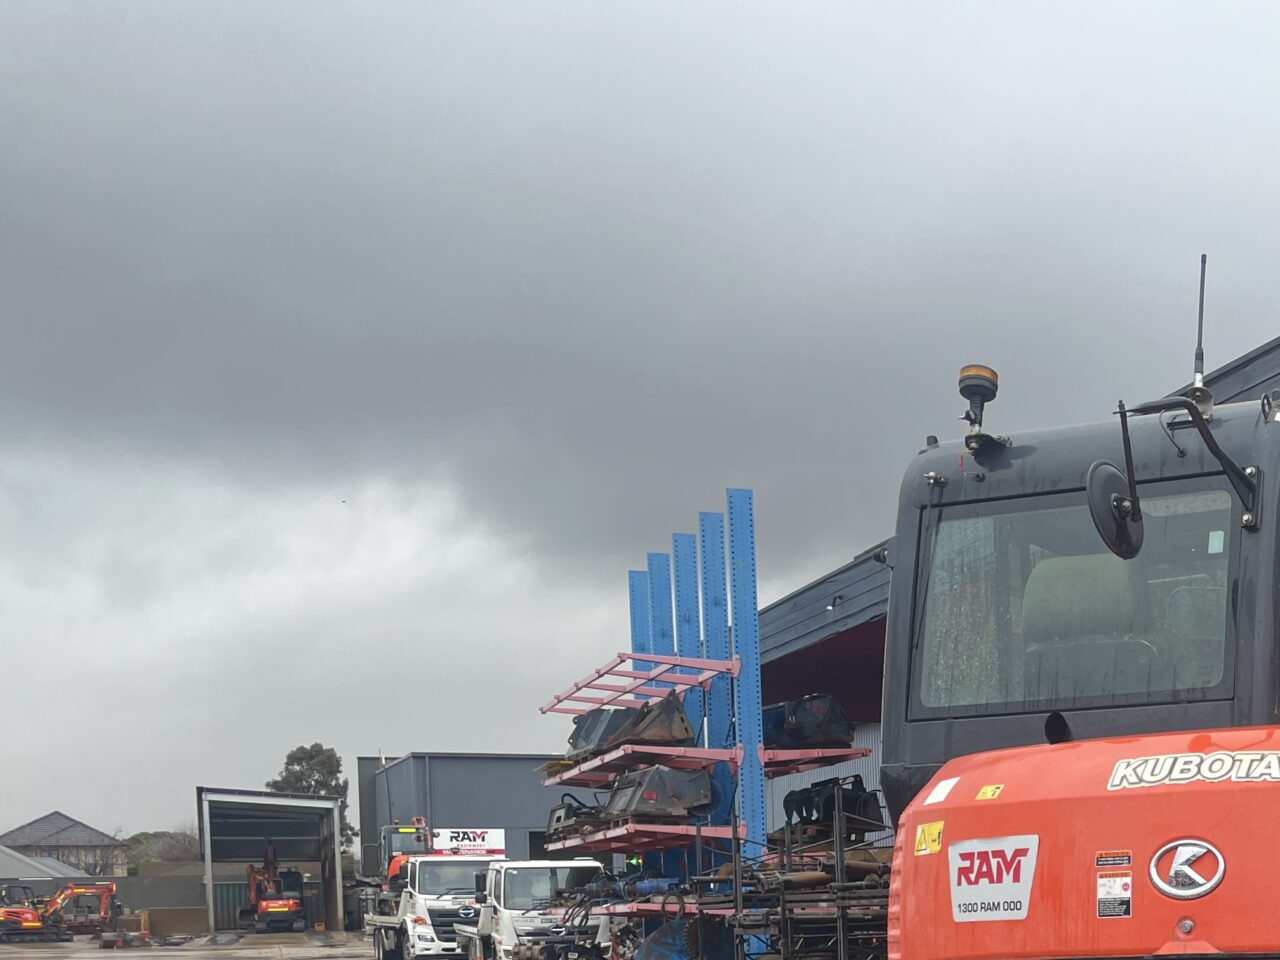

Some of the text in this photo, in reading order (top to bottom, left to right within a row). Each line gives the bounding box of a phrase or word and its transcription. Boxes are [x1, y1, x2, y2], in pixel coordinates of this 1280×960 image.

[449, 831, 489, 842] RAM
[956, 847, 1030, 887] RAM
[957, 900, 1022, 914] 1300 RAM 000
